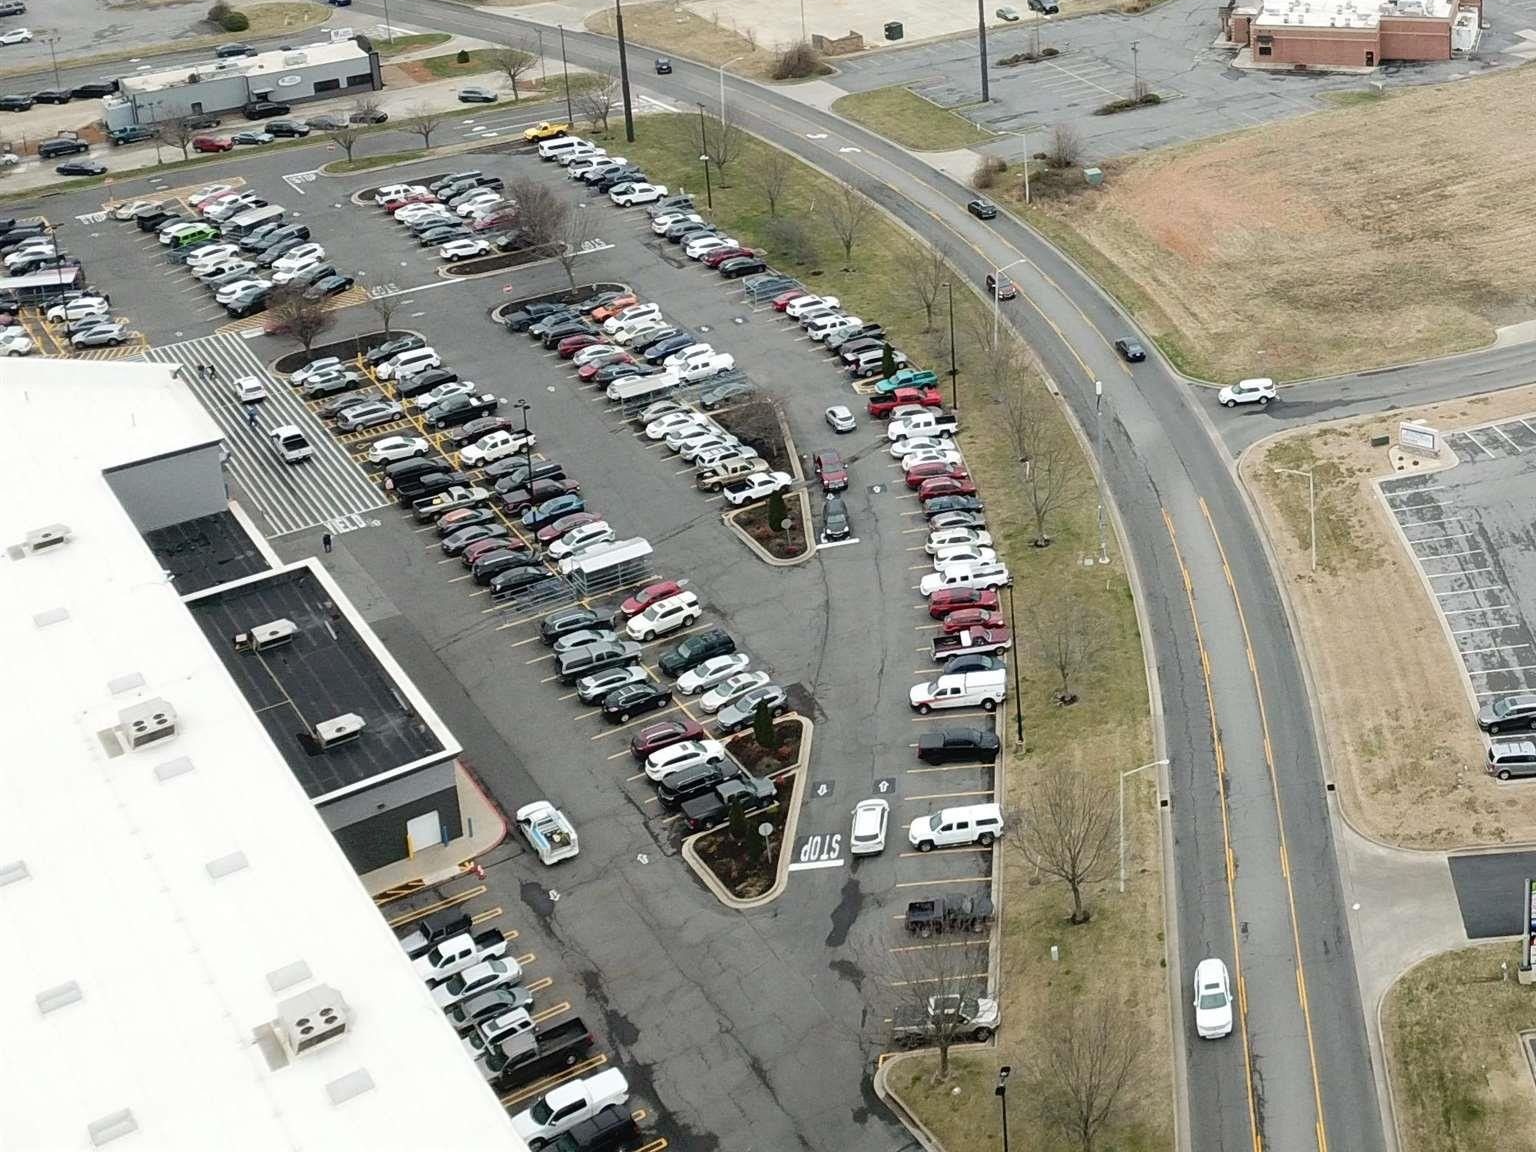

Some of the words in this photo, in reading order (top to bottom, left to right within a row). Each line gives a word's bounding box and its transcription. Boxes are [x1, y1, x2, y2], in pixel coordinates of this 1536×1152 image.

[292, 174, 316, 185] STOP
[79, 212, 107, 225] STOP
[800, 834, 841, 862] STOP
